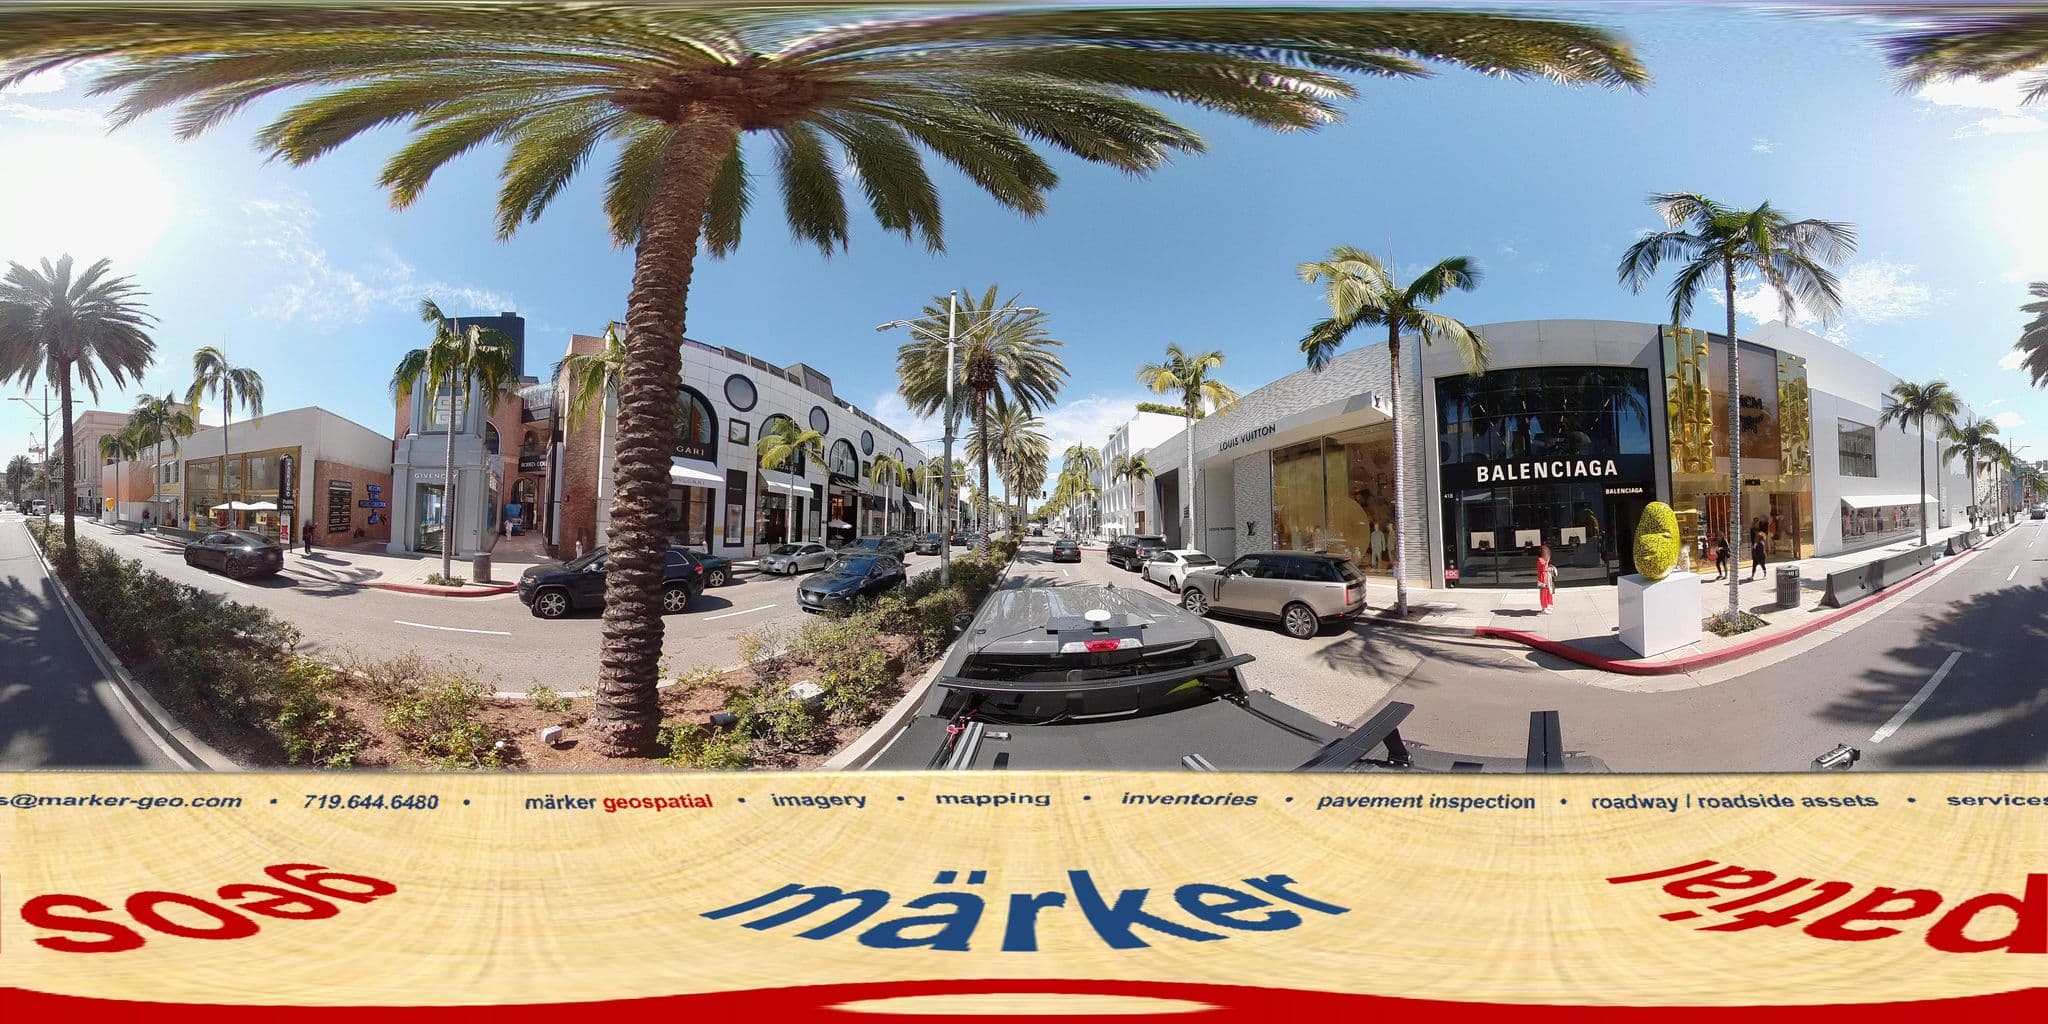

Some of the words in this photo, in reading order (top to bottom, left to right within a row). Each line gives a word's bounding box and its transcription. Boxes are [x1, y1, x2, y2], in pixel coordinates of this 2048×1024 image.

[1219, 438, 1238, 452] LOUIS
[1241, 423, 1276, 444] VUITTON
[1476, 459, 1618, 483] BALENCIAGA
[1605, 487, 1643, 495] BALENCIAGA
